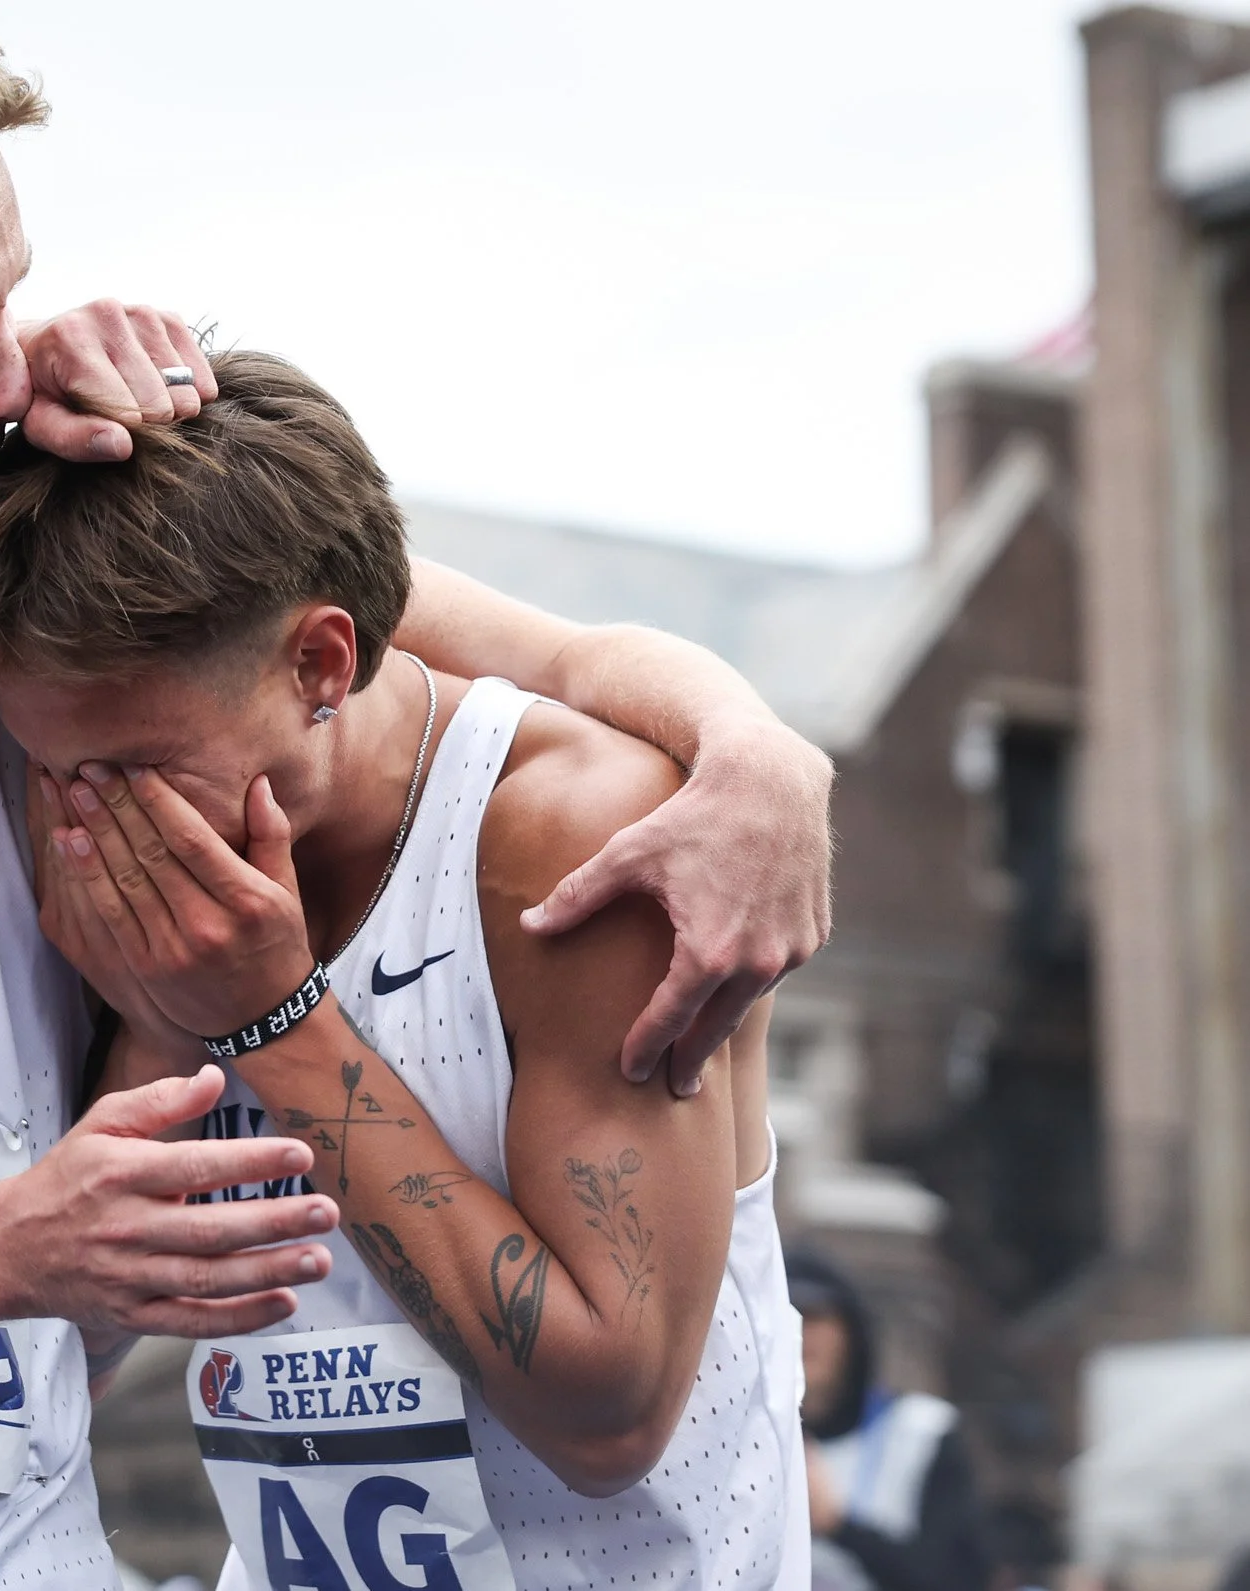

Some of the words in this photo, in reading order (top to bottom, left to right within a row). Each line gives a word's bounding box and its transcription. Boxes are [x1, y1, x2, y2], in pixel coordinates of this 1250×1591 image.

[267, 961, 330, 1035] LEAR
[262, 1343, 378, 1385] PENN
[268, 1377, 421, 1420] RELAYS
[258, 1475, 464, 1591] AG
